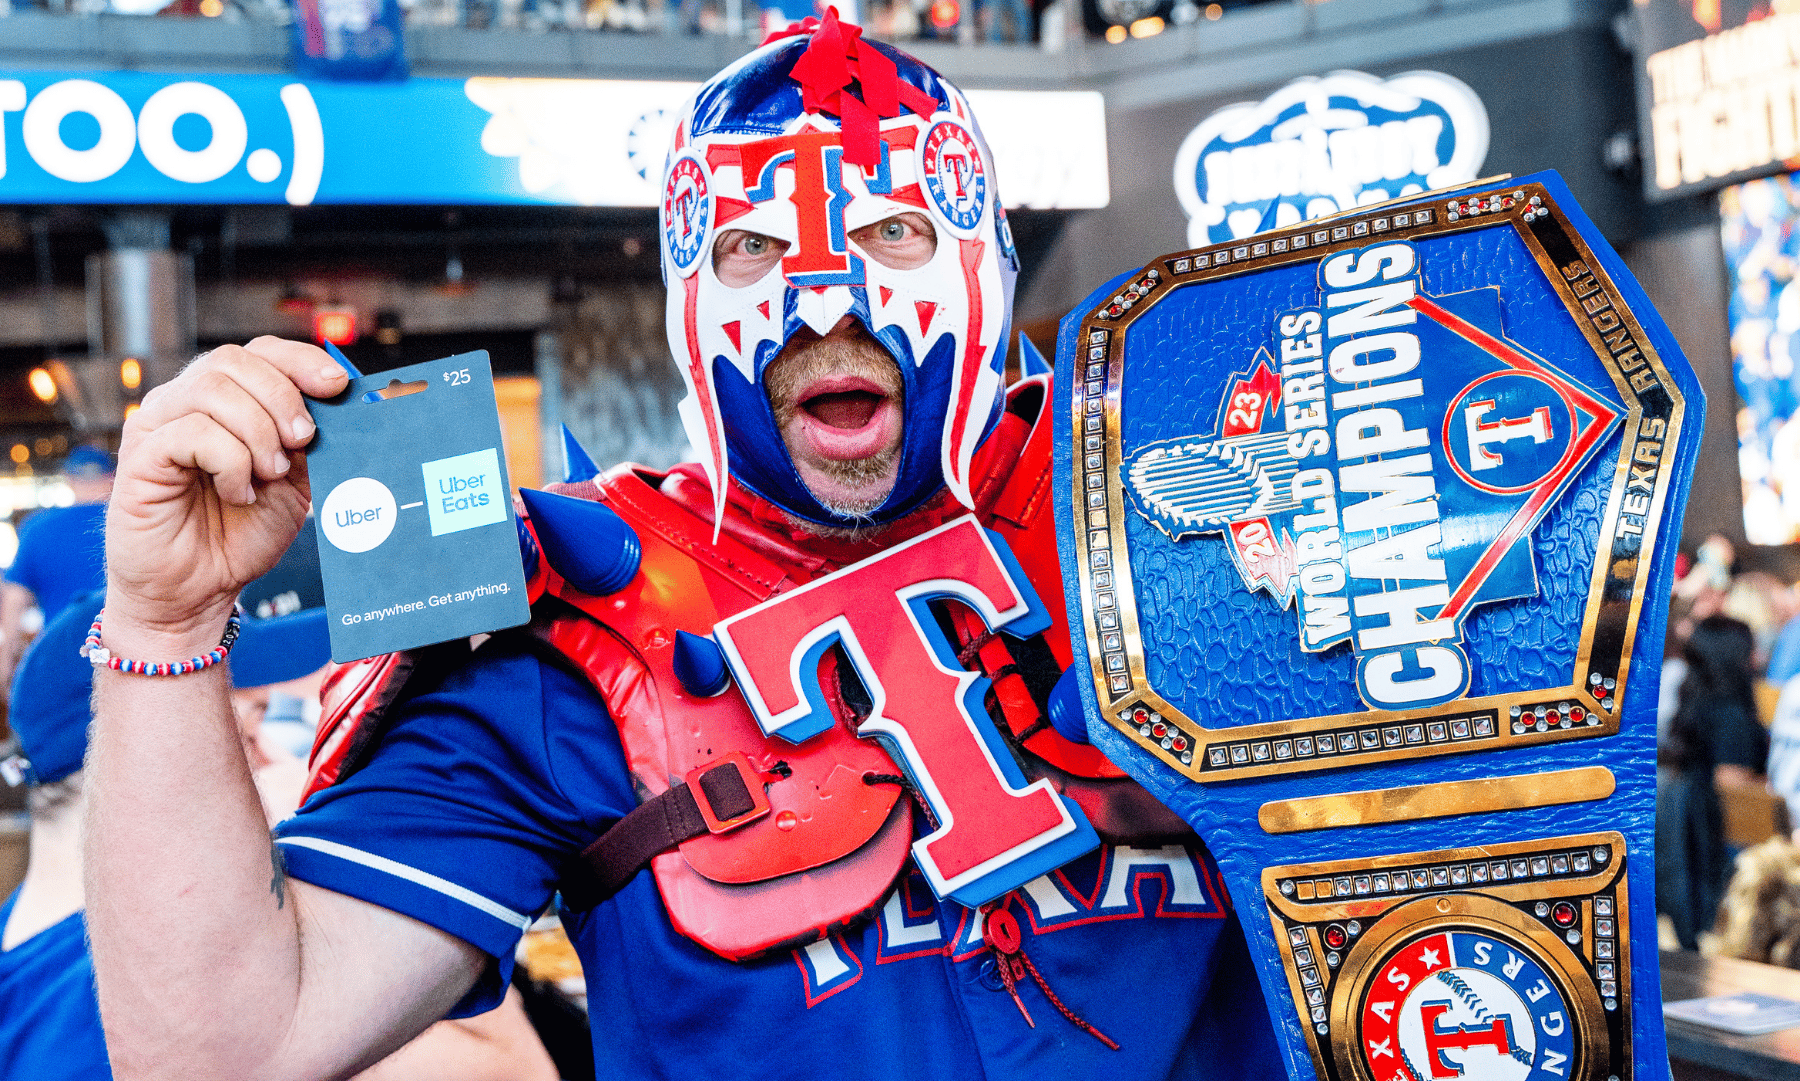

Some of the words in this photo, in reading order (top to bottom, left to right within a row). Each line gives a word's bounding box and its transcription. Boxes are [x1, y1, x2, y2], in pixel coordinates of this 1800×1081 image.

[927, 124, 976, 153] TEXAS
[1562, 259, 1660, 395] RANGERS
[443, 368, 471, 386] $25
[1280, 310, 1331, 459] SERIES
[1229, 392, 1262, 429] 23
[1464, 399, 1554, 472] T
[439, 474, 486, 494] Uber
[1326, 243, 1464, 704] CHAMPIONS
[1616, 417, 1666, 540] TEXAS
[336, 507, 382, 528] Uber
[442, 492, 490, 514] Eats
[1238, 522, 1275, 564] 20
[1291, 468, 1352, 646] WORLD
[342, 614, 362, 626] Go
[364, 601, 427, 621] anywhere.
[428, 593, 452, 607] Get
[454, 582, 511, 602] anything.
[1420, 999, 1517, 1079] T
